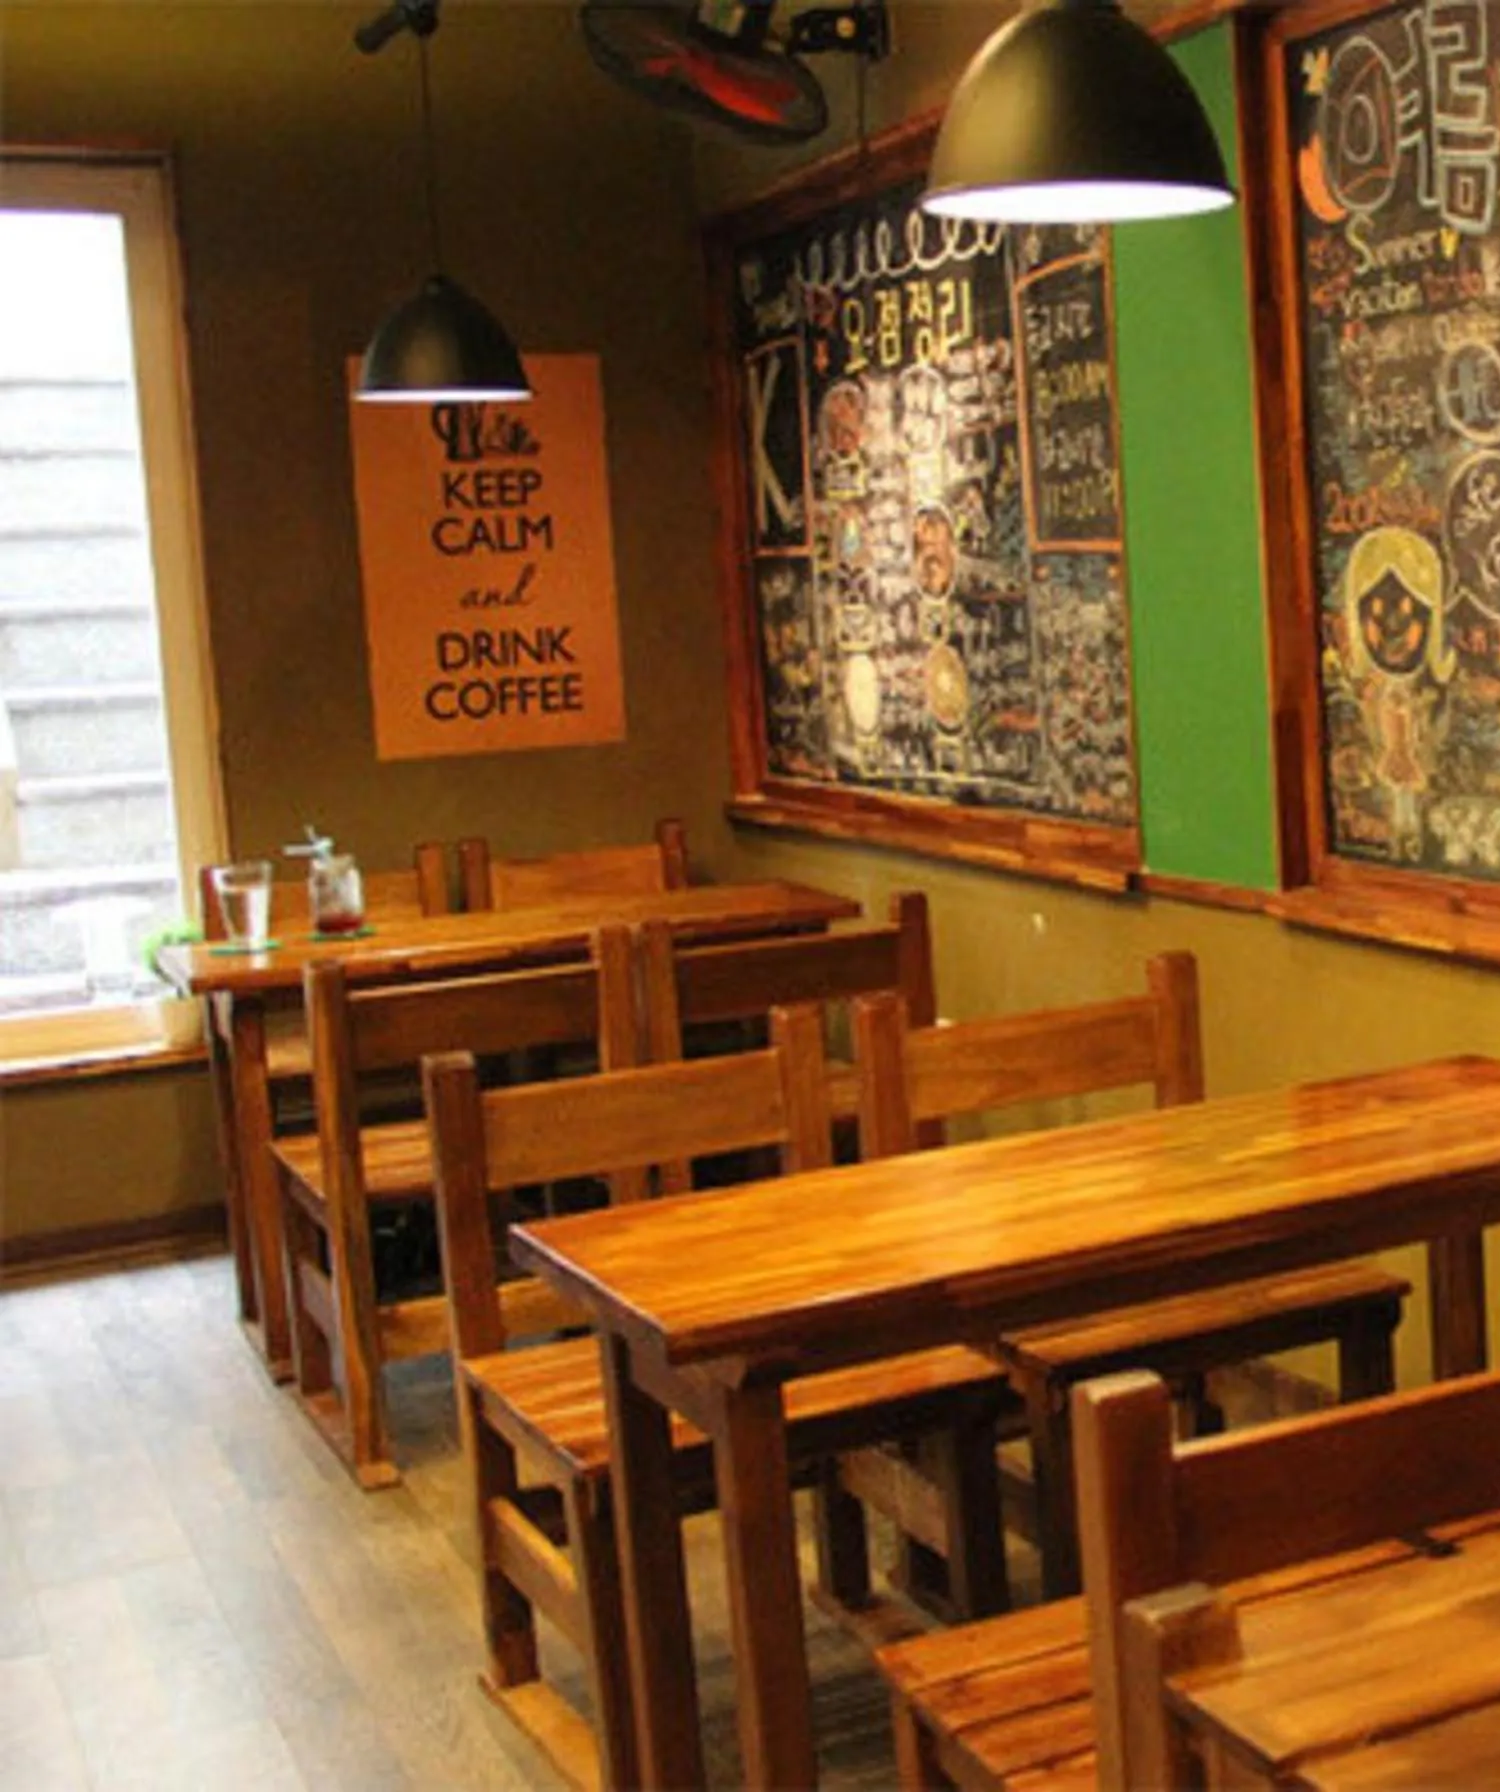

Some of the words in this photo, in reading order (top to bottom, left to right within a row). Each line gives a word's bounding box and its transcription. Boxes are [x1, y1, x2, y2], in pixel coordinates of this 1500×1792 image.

[441, 467, 543, 511] KEEP
[430, 514, 555, 557] CALM
[459, 563, 539, 610] and
[436, 626, 576, 674] DRINK
[424, 673, 584, 723] COFFEE
